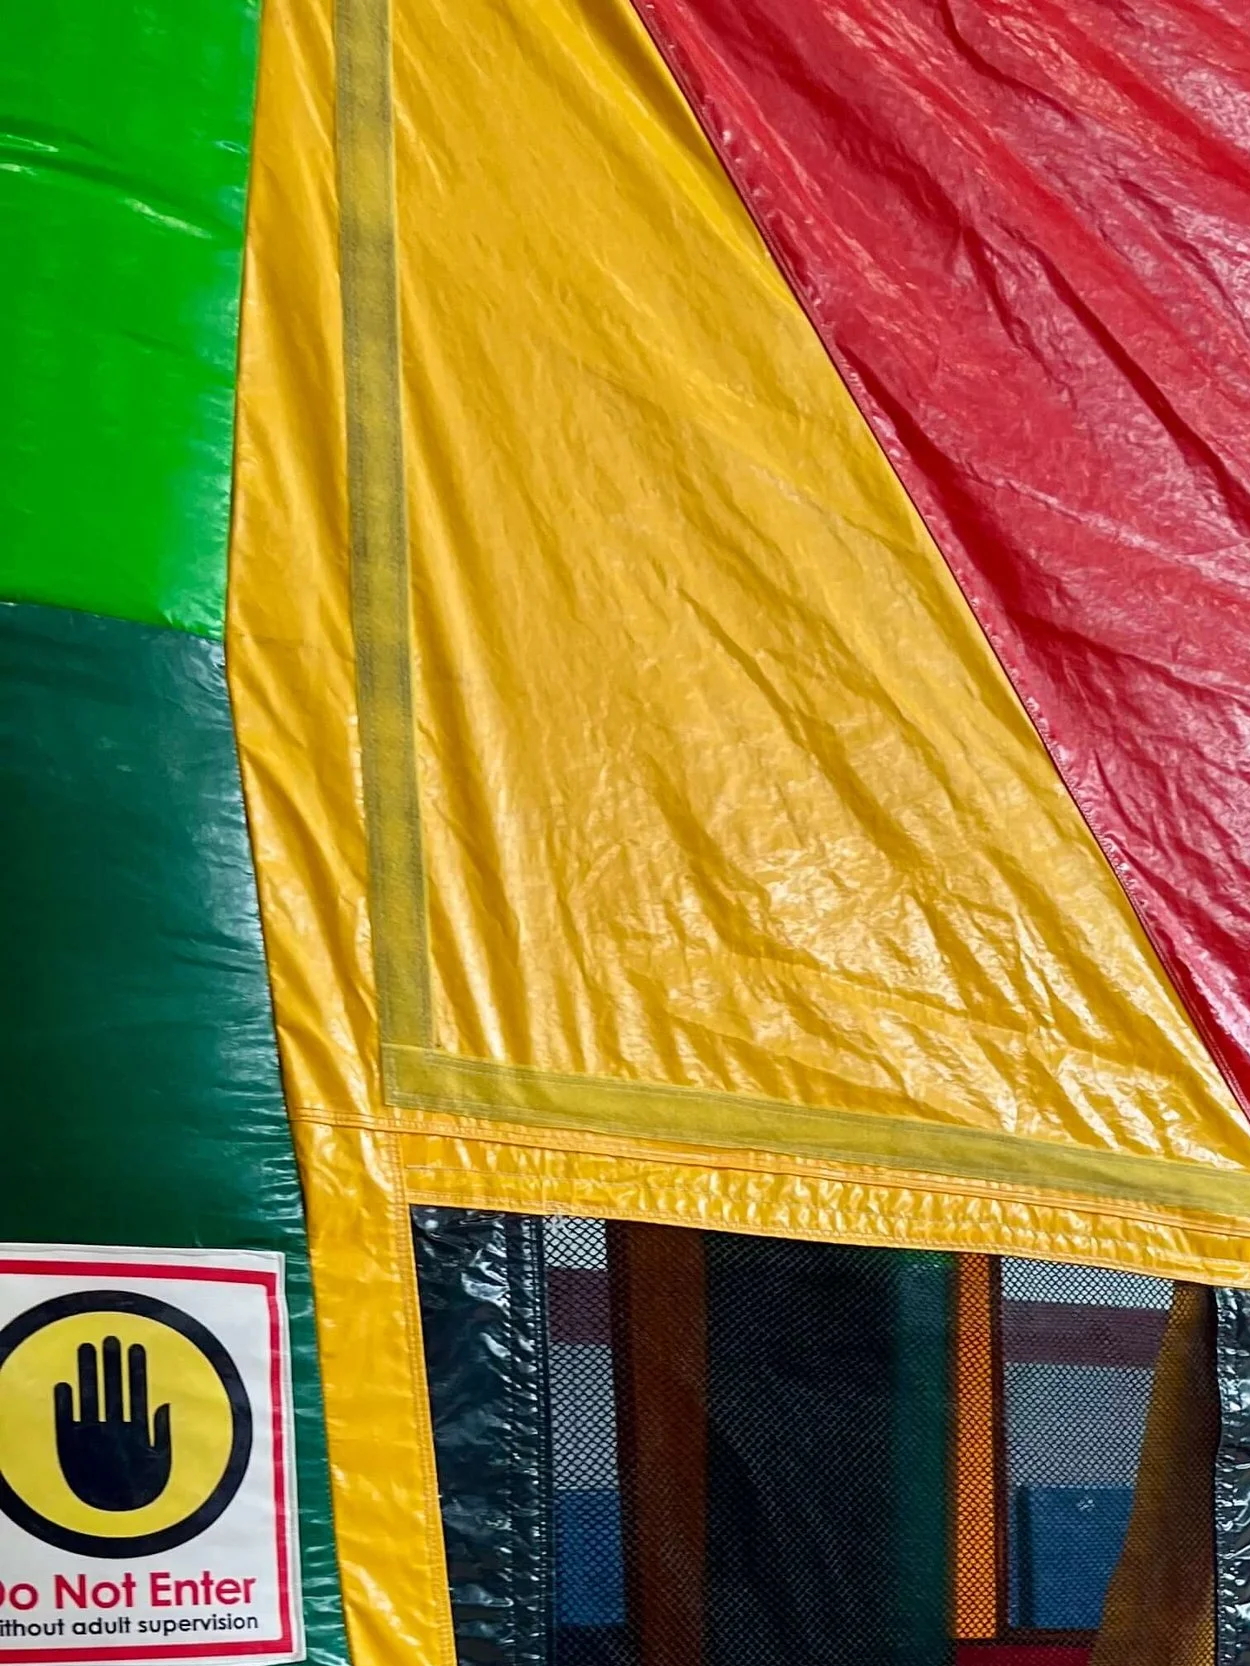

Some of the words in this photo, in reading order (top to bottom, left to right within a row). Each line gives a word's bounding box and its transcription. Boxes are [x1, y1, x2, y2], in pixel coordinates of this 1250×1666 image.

[0, 1579, 39, 1611] o
[54, 1573, 137, 1609] Not
[149, 1570, 256, 1607] Enter
[0, 1618, 64, 1637] ithout
[72, 1616, 131, 1635] adult
[138, 1612, 258, 1636] supervision
